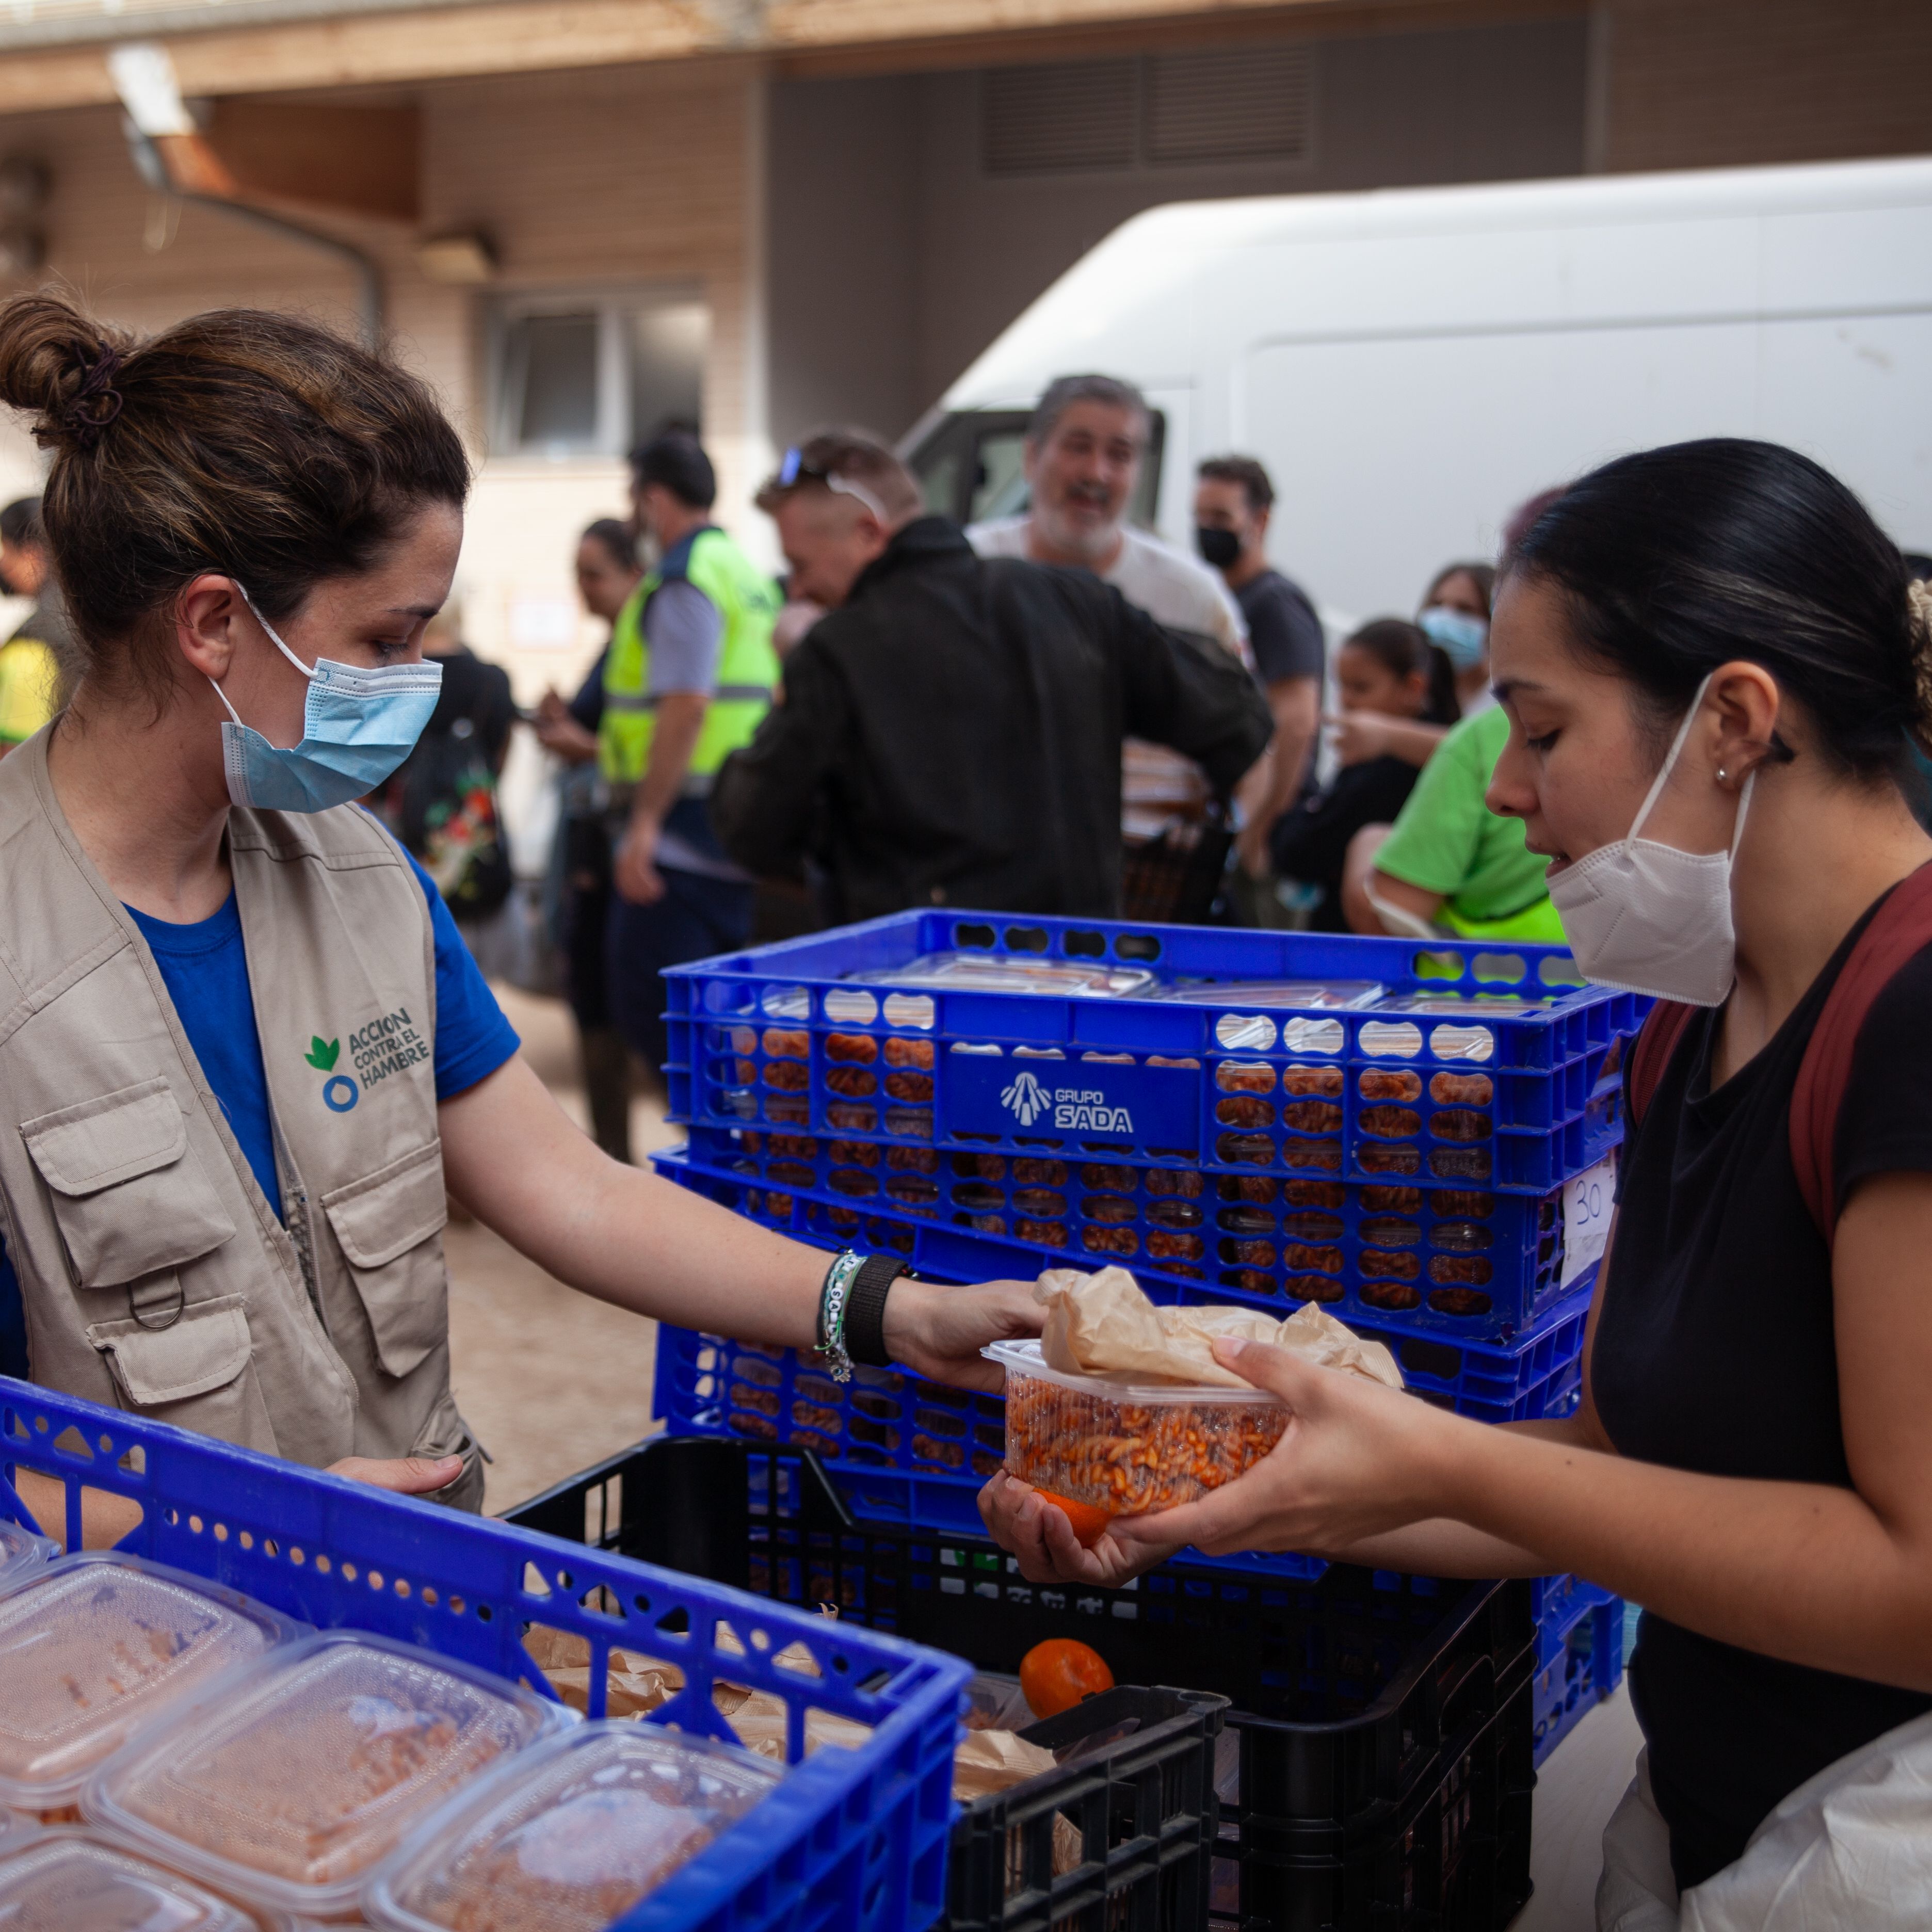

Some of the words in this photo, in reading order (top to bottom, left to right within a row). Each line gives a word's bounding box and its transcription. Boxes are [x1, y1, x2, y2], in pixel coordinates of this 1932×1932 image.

[348, 1007, 412, 1055] ACCION
[354, 1036, 405, 1070] CONTRA
[401, 1028, 420, 1044] EL
[359, 1041, 429, 1090] HAMBRE
[1055, 1089, 1104, 1104] GRUPO
[1055, 1105, 1134, 1133] SADA
[1576, 1180, 1601, 1226] 30
